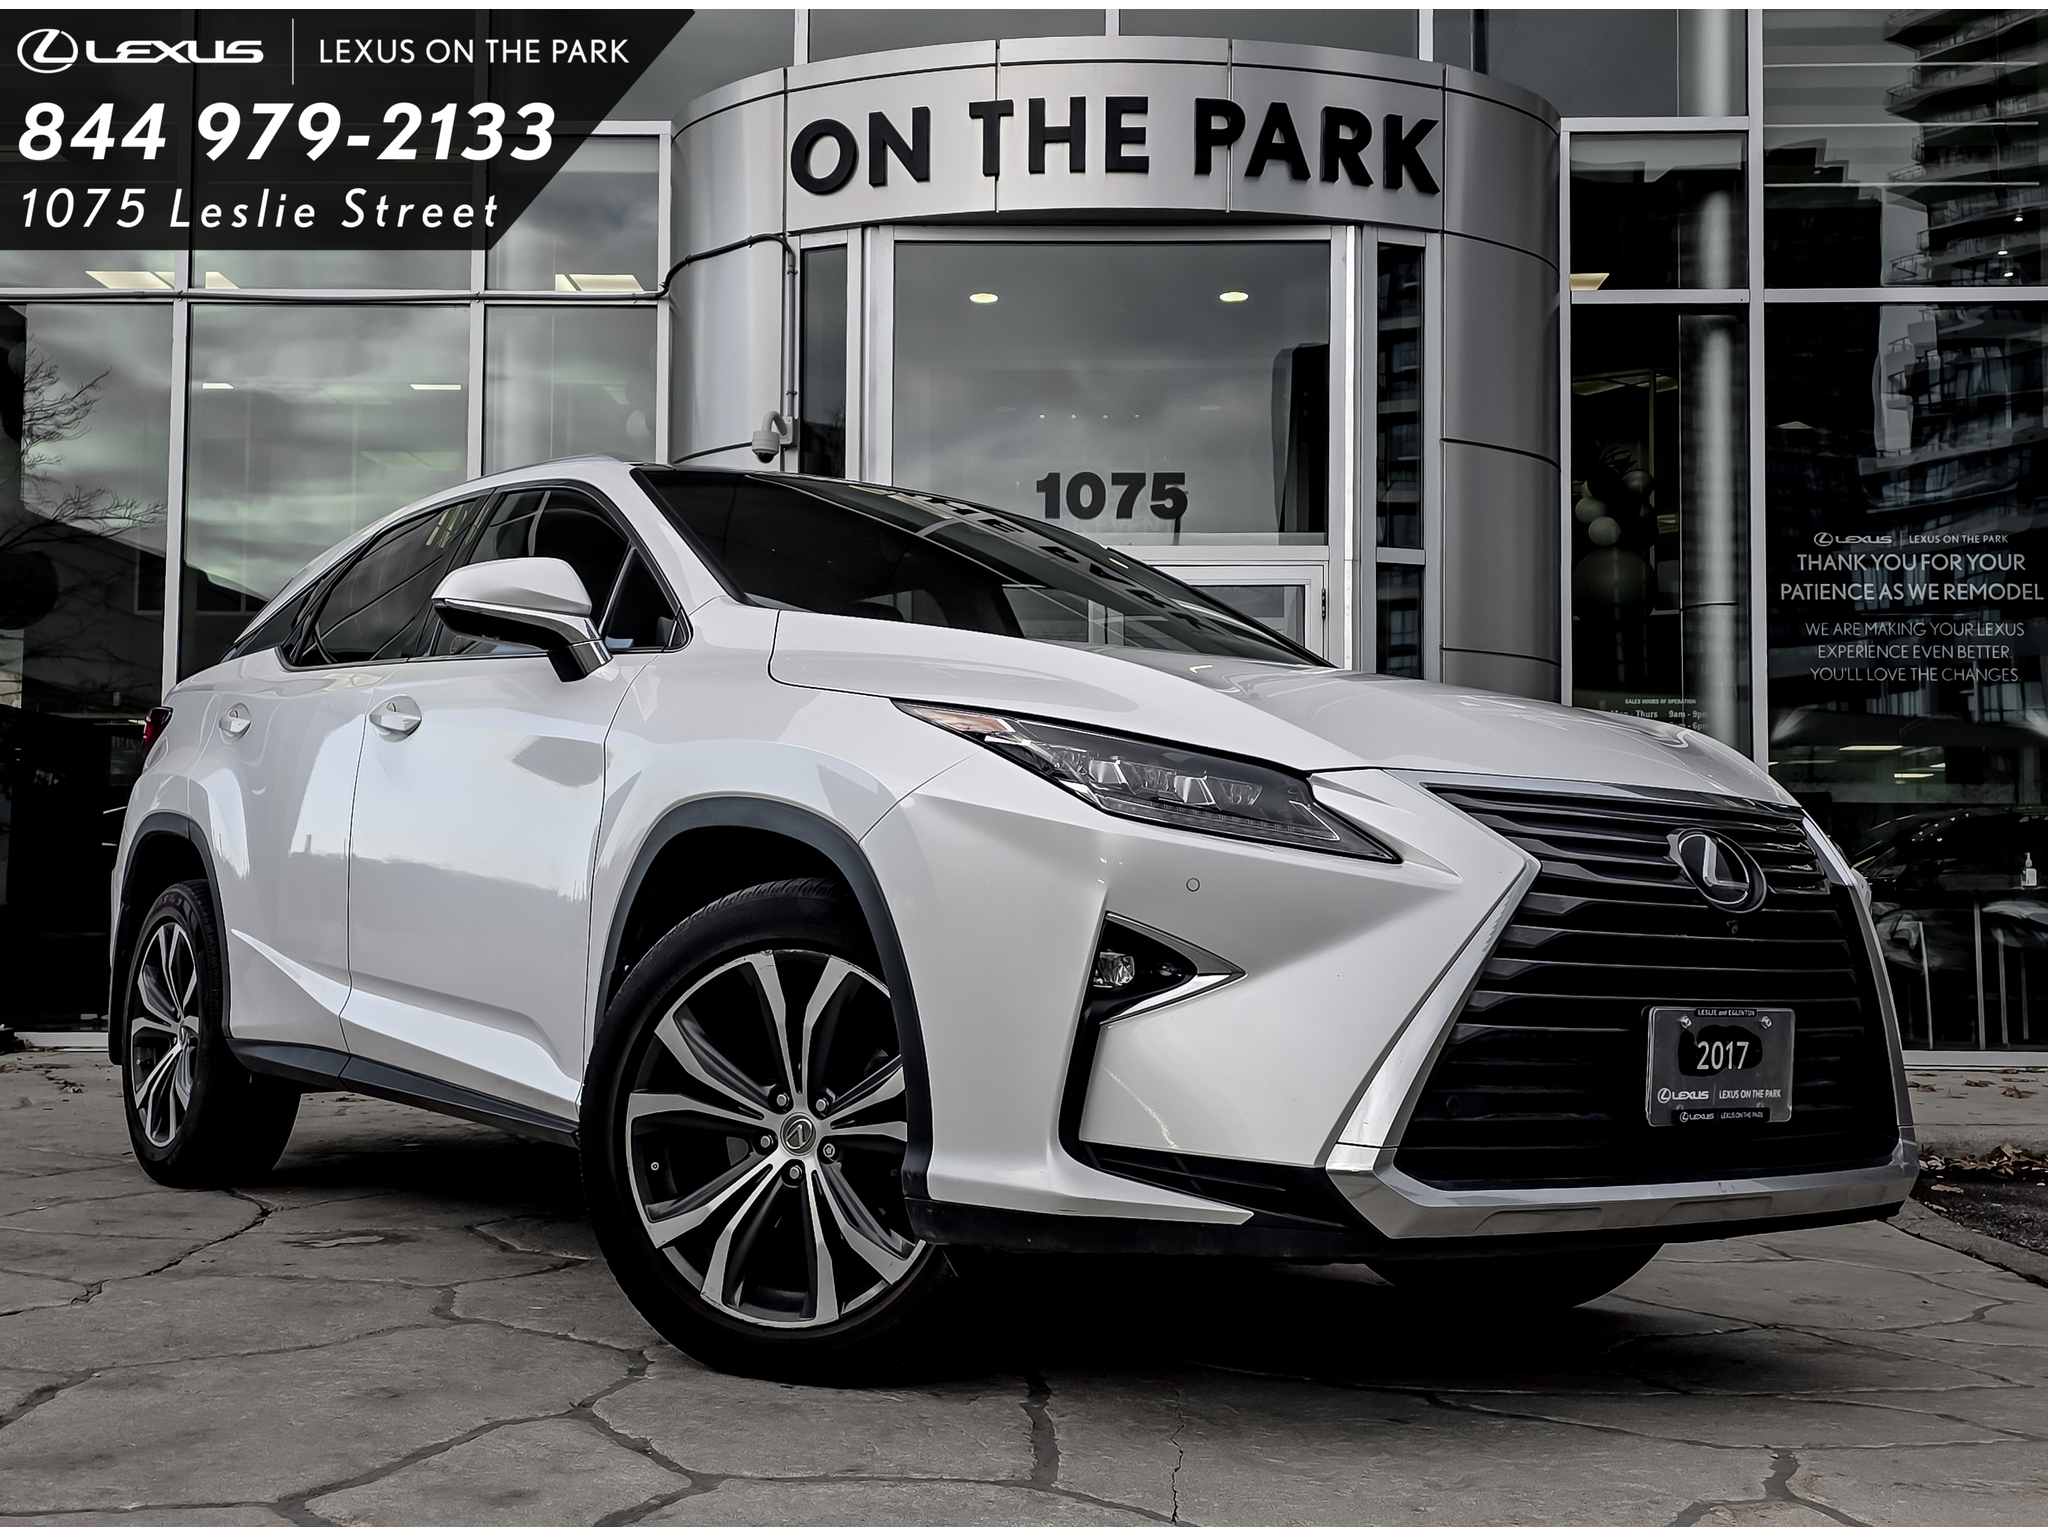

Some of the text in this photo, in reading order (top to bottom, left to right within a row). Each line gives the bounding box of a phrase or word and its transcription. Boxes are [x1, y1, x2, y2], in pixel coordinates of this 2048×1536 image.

[790, 96, 1440, 195] ON THE PARK
[1036, 472, 1188, 520] 1075
[1836, 536, 1892, 544] LEXUS
[1909, 535, 2009, 544] LEXUS ON THE PARK
[1797, 554, 2026, 571] THANK YOU FOR YOUR
[1781, 583, 2045, 601] PATIENCE AS WE REMODEL
[1805, 622, 2025, 637] WE ARE MAKING YOUR LEXUS
[1818, 644, 2013, 659] EXPERIENCE EVEN BETTER.
[1810, 667, 2021, 682] YOU'LL LOVE THE CHANGES.
[1635, 710, 1658, 718] Thurs
[1669, 710, 1686, 718] 9am
[1692, 710, 1709, 720] 9pm
[1692, 722, 1709, 732] 6pm
[1696, 1041, 1749, 1070] 2017
[1672, 1091, 1709, 1100] LEXUS
[1719, 1089, 1781, 1099] LEXUS ON THE PARK
